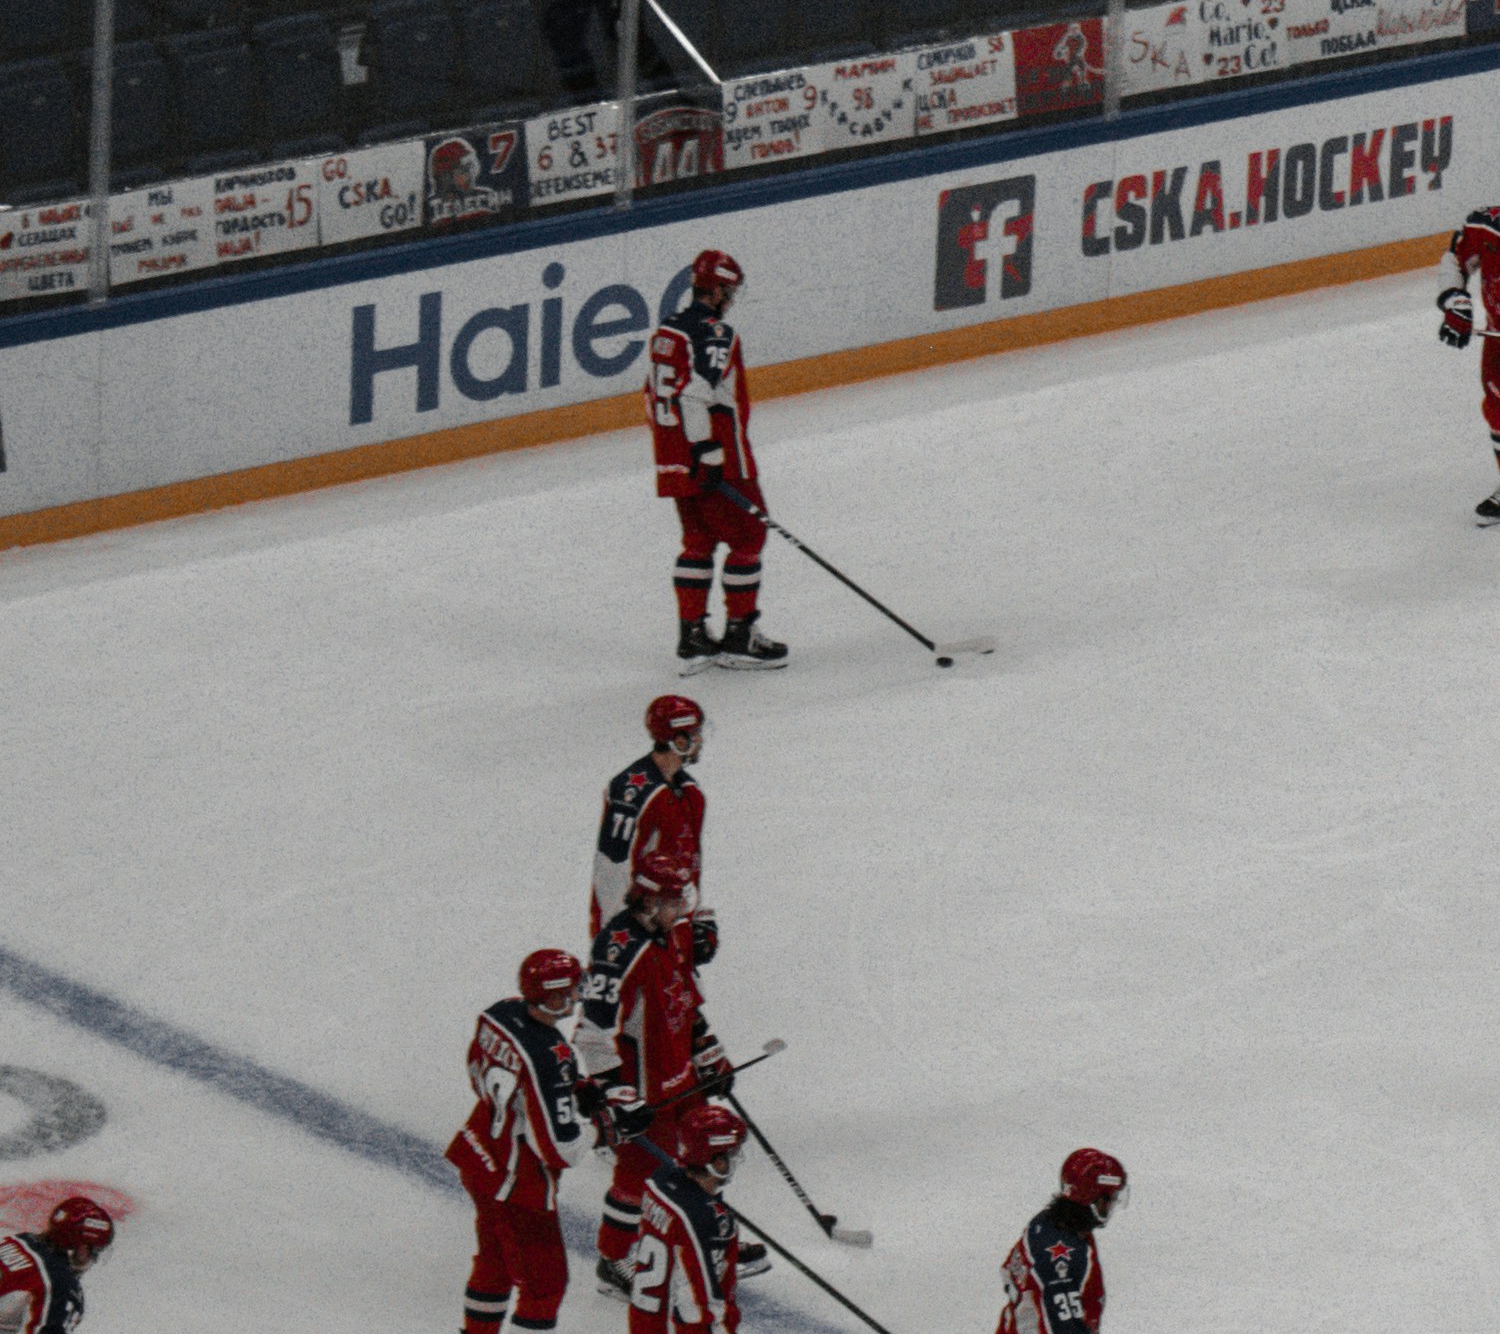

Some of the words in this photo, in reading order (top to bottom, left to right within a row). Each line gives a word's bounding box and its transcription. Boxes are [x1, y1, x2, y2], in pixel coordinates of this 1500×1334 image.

[1217, 55, 1242, 76] 23
[803, 85, 817, 110] 9
[548, 112, 597, 141] BEST
[488, 130, 517, 173] 7
[537, 146, 552, 171] 6
[569, 142, 588, 168] &
[1081, 116, 1454, 257] CSKA.HOCKEY
[286, 184, 313, 229] 15
[350, 263, 695, 426] Haie
[611, 812, 635, 842] 71
[591, 973, 621, 1005] 23
[1053, 1291, 1085, 1323] 35
